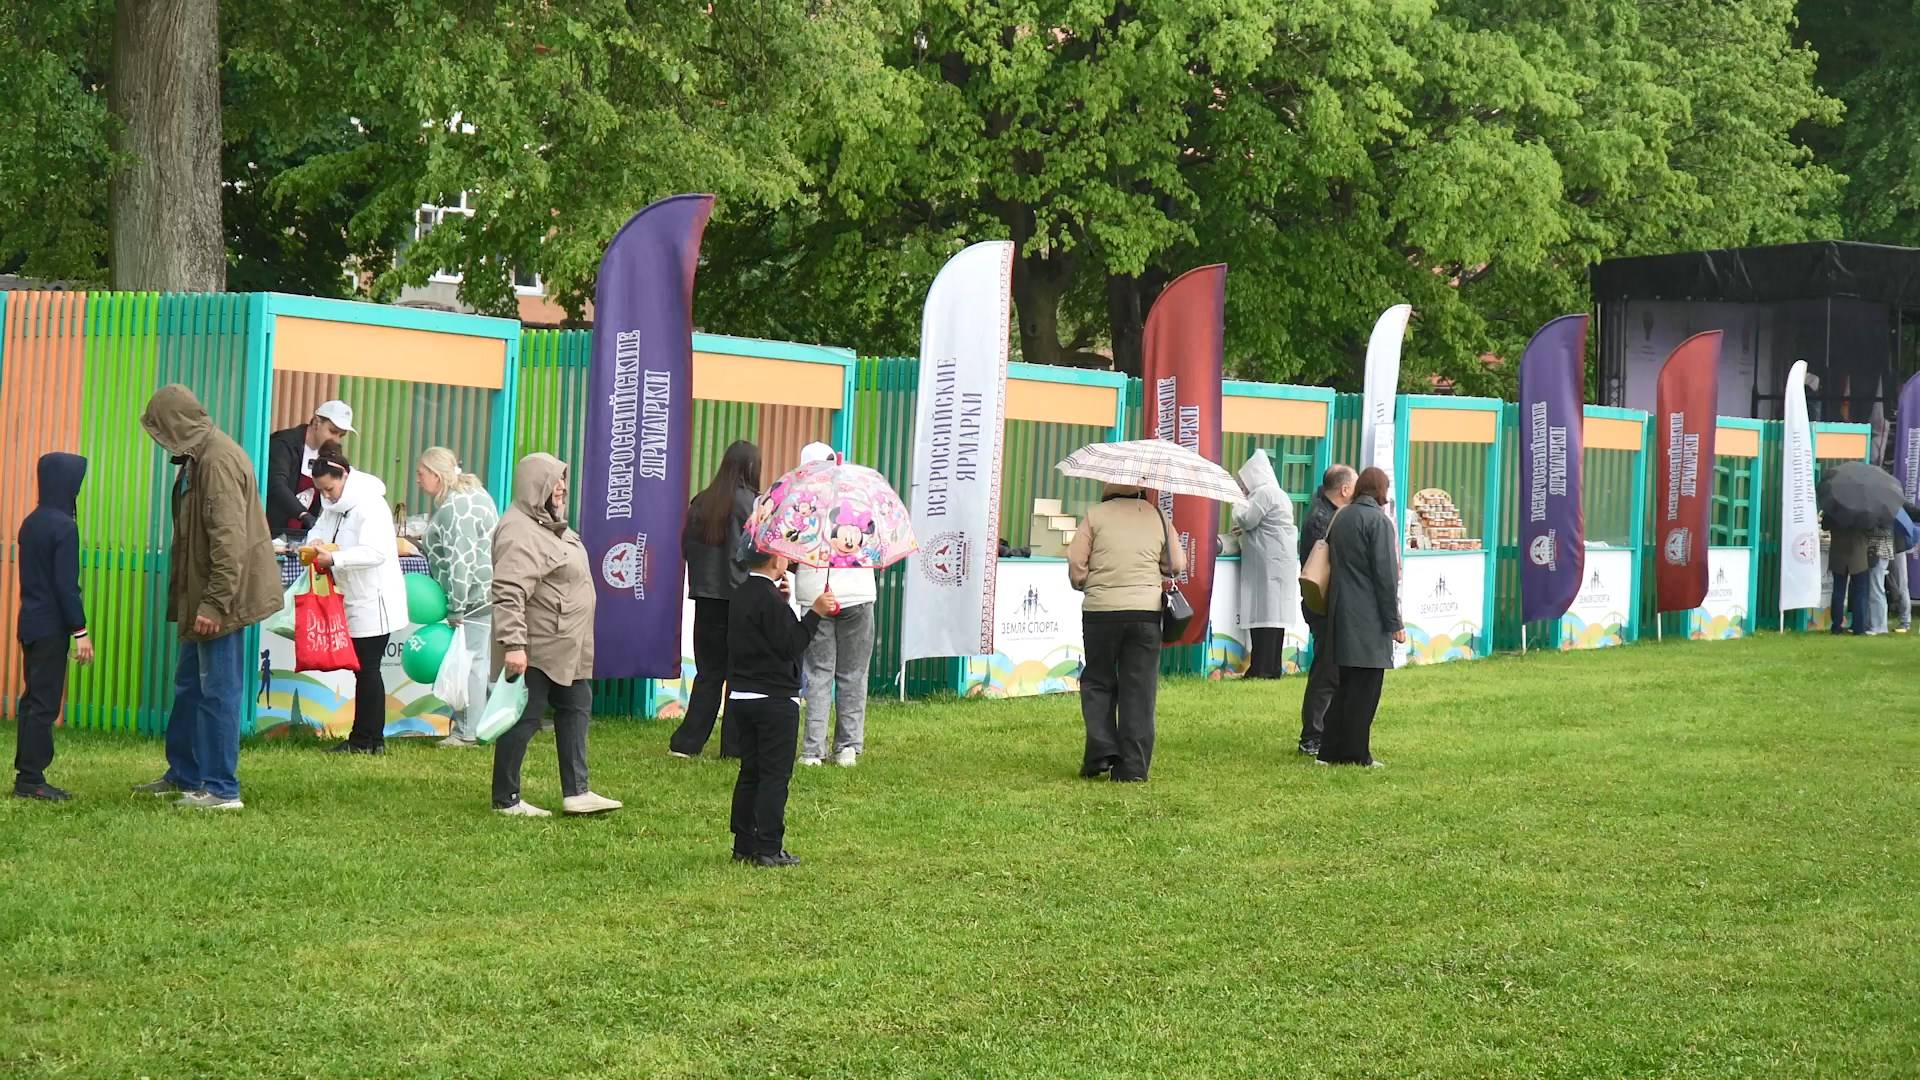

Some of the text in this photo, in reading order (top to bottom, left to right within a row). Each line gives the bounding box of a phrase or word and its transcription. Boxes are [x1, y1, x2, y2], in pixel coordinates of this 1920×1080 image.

[606, 330, 640, 520] ВСЕРОССИЙСКИЕ
[640, 369, 670, 480] ЯРМАРКИ
[927, 357, 957, 518] ВСЕРОССИЙСКИЕ
[956, 391, 982, 482] ЯРМАРКИ
[1530, 401, 1547, 522] ВСЕРОССИЙСКИЕ
[1550, 426, 1567, 496] ЯРМАРКИ
[1001, 621, 1059, 634] ЗЕМЛЯ СПОРТА
